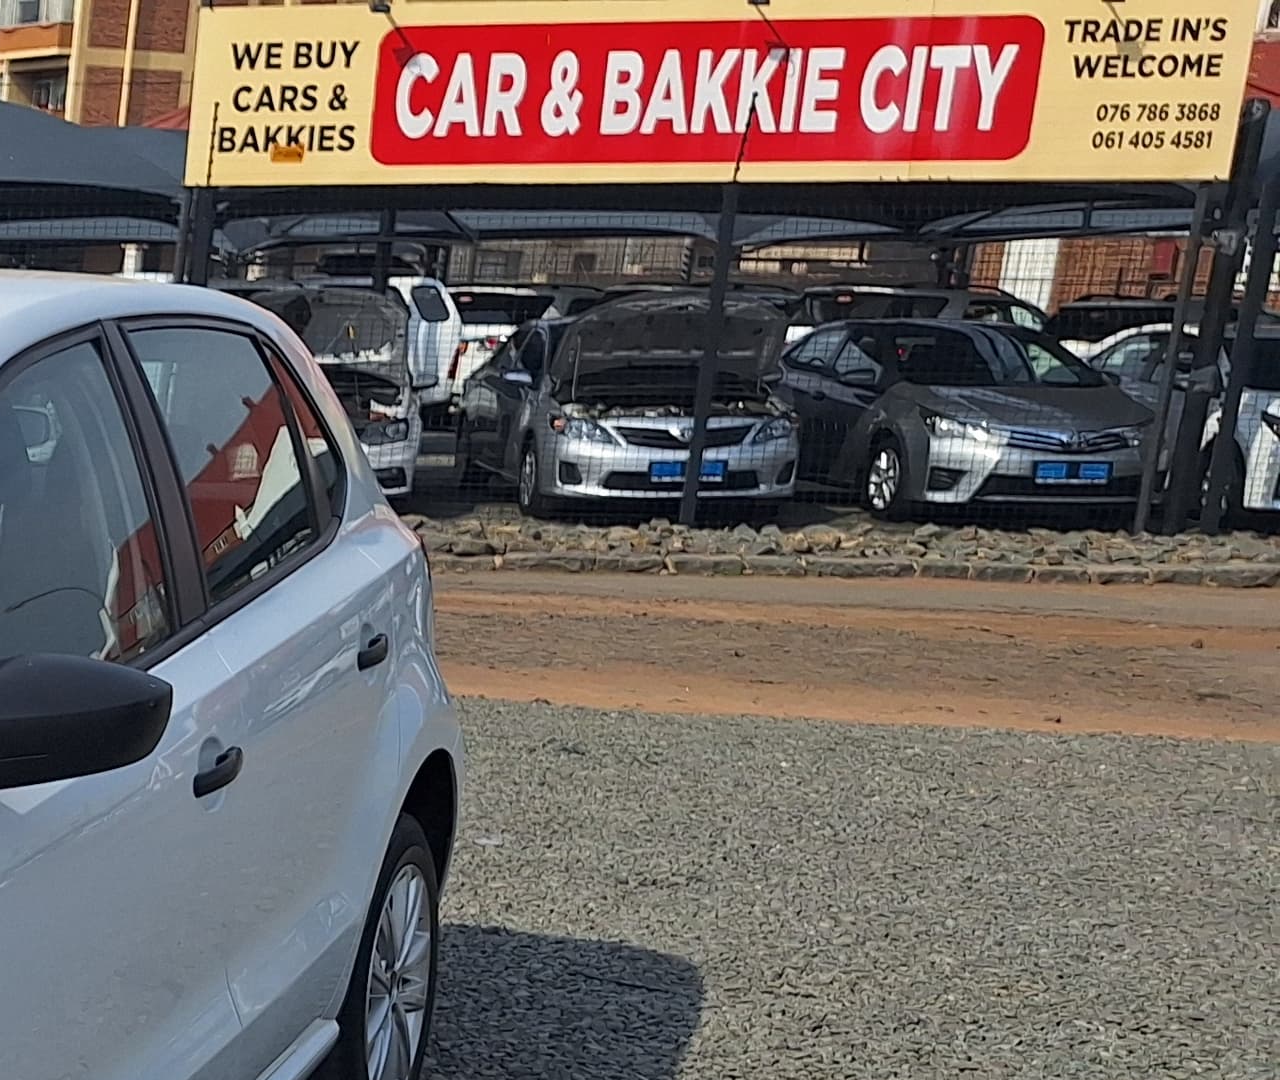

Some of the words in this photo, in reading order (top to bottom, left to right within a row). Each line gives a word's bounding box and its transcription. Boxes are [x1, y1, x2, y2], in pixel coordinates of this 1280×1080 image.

[1064, 18, 1163, 43] TRADE
[1171, 18, 1228, 42] IN'S
[232, 42, 283, 70] WE
[293, 41, 360, 69] BUY
[1073, 53, 1223, 78] WELCOME
[233, 85, 318, 112] CARS
[328, 84, 348, 111] &
[395, 52, 527, 139] CAR
[541, 50, 583, 137] &
[599, 46, 846, 135] BAKKIE
[859, 44, 1020, 133] CITY
[1096, 103, 1131, 122] 076
[1136, 103, 1170, 122] 786
[1175, 103, 1221, 122] 3868
[218, 125, 355, 152] BAKKIES
[1092, 130, 1124, 149] 061
[1128, 130, 1166, 149] 405
[1170, 130, 1213, 149] 4581
